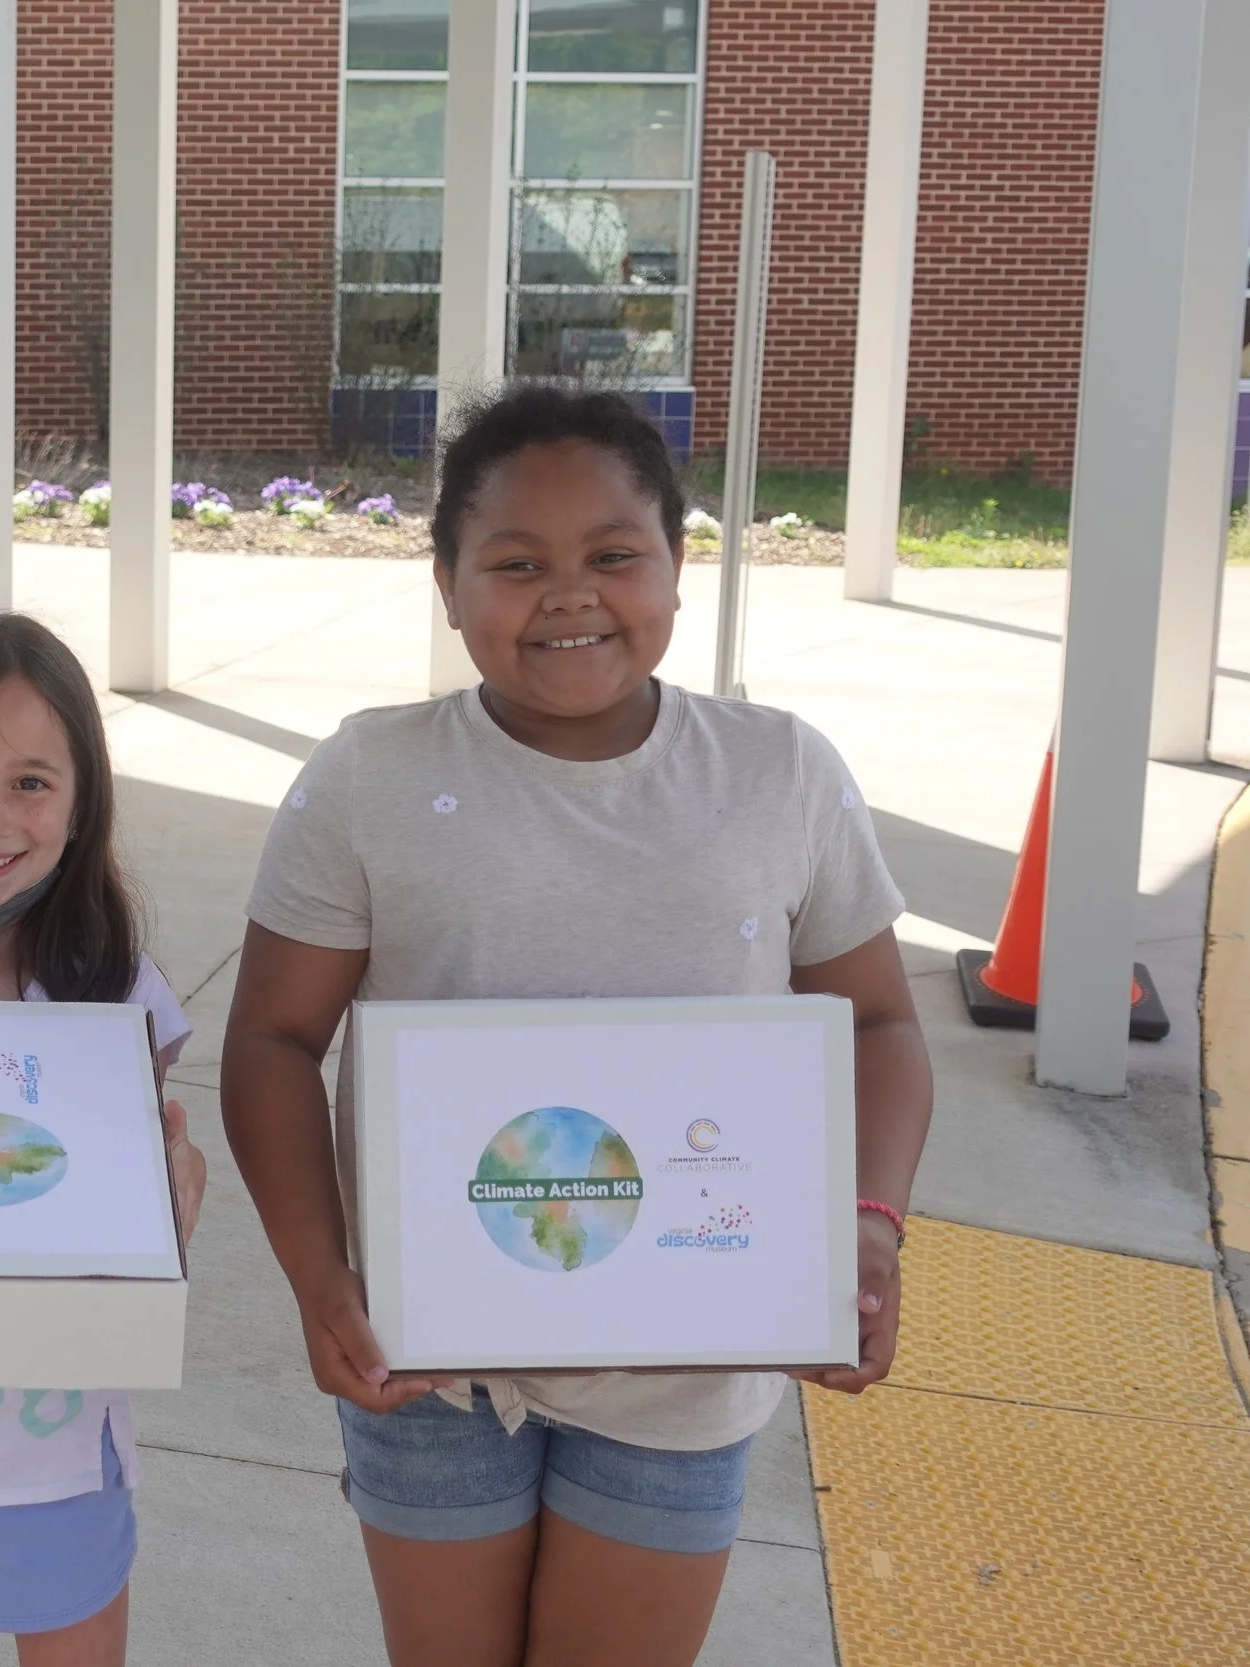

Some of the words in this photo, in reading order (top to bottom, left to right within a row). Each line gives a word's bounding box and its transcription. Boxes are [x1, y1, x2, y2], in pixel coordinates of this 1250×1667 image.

[23, 1054, 39, 1105] discovery
[656, 1162, 751, 1173] COLLABORATIVE
[471, 1183, 546, 1199] Climate
[549, 1181, 609, 1197] Action
[613, 1180, 640, 1196] Kit
[700, 1188, 708, 1197] &
[656, 1233, 750, 1249] discovery
